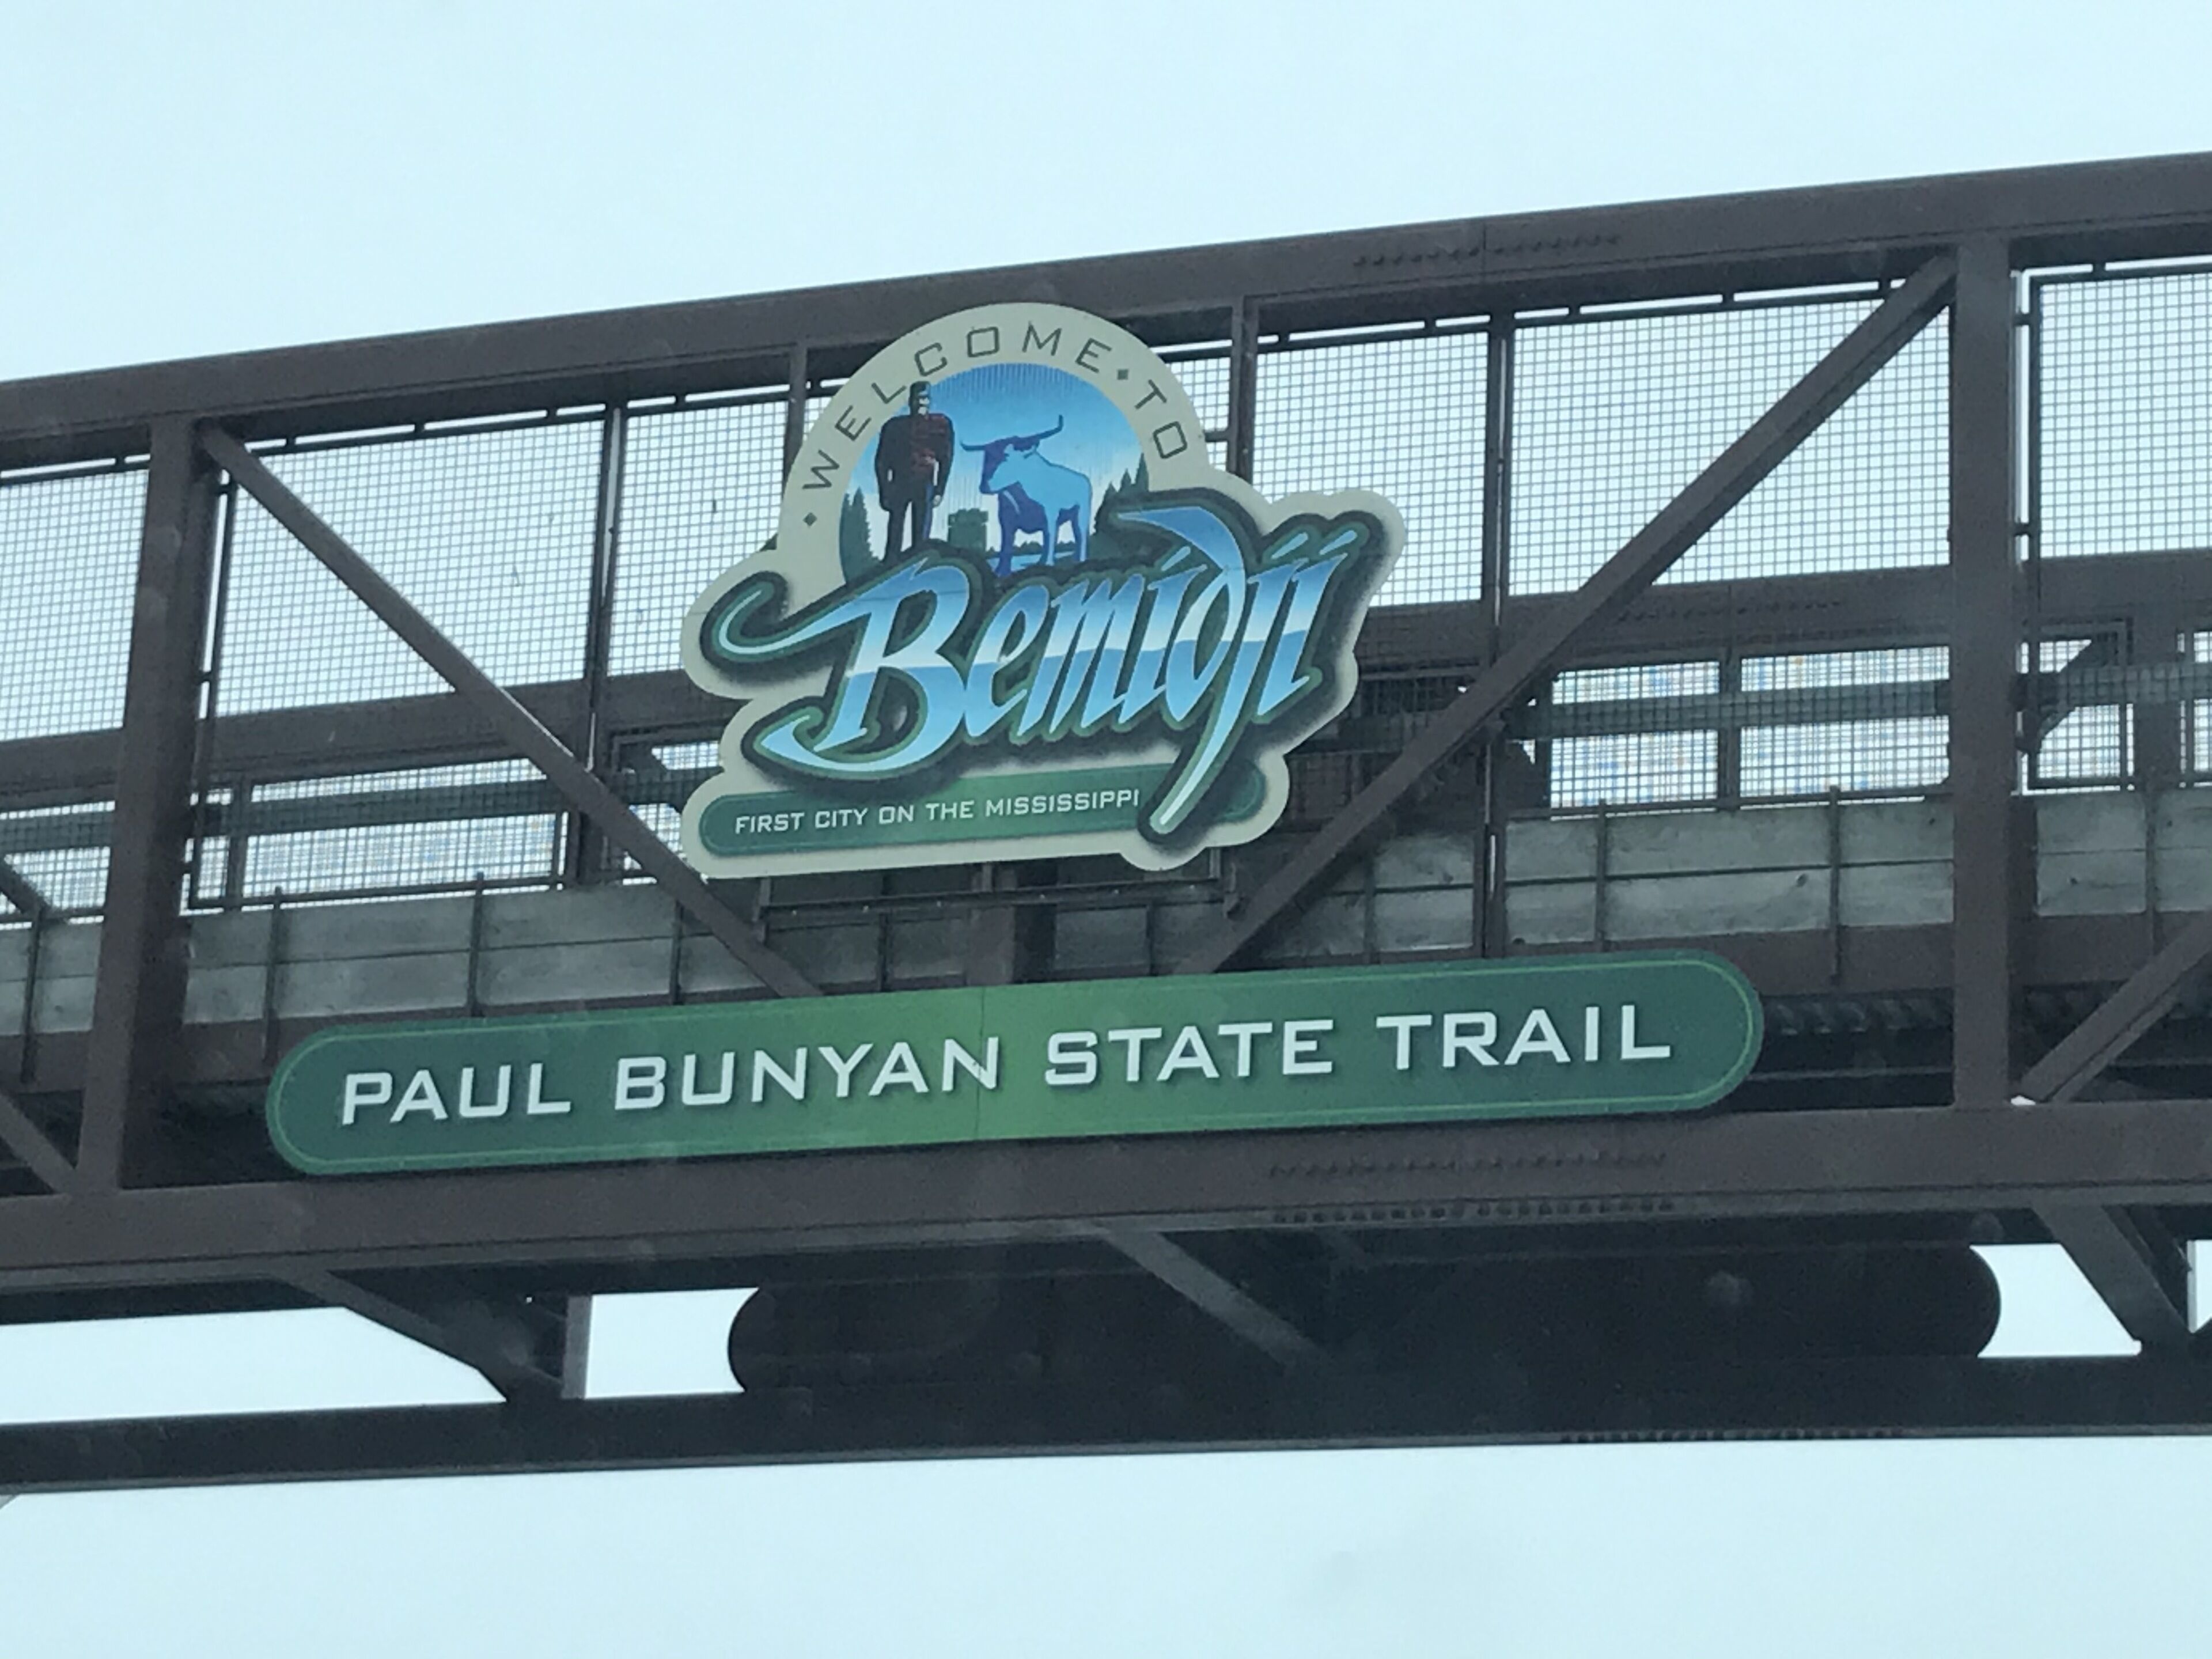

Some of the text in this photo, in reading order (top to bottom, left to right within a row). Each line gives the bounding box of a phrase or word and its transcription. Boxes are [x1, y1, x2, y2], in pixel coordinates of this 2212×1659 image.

[802, 323, 1188, 491] WELCOME TO
[717, 506, 1358, 831] Bemidji
[735, 789, 1140, 834] FIRST CITY ON THE MISSISSIPPI
[342, 1004, 1671, 1125] PAUL BUNYAN STATE TRAIL
